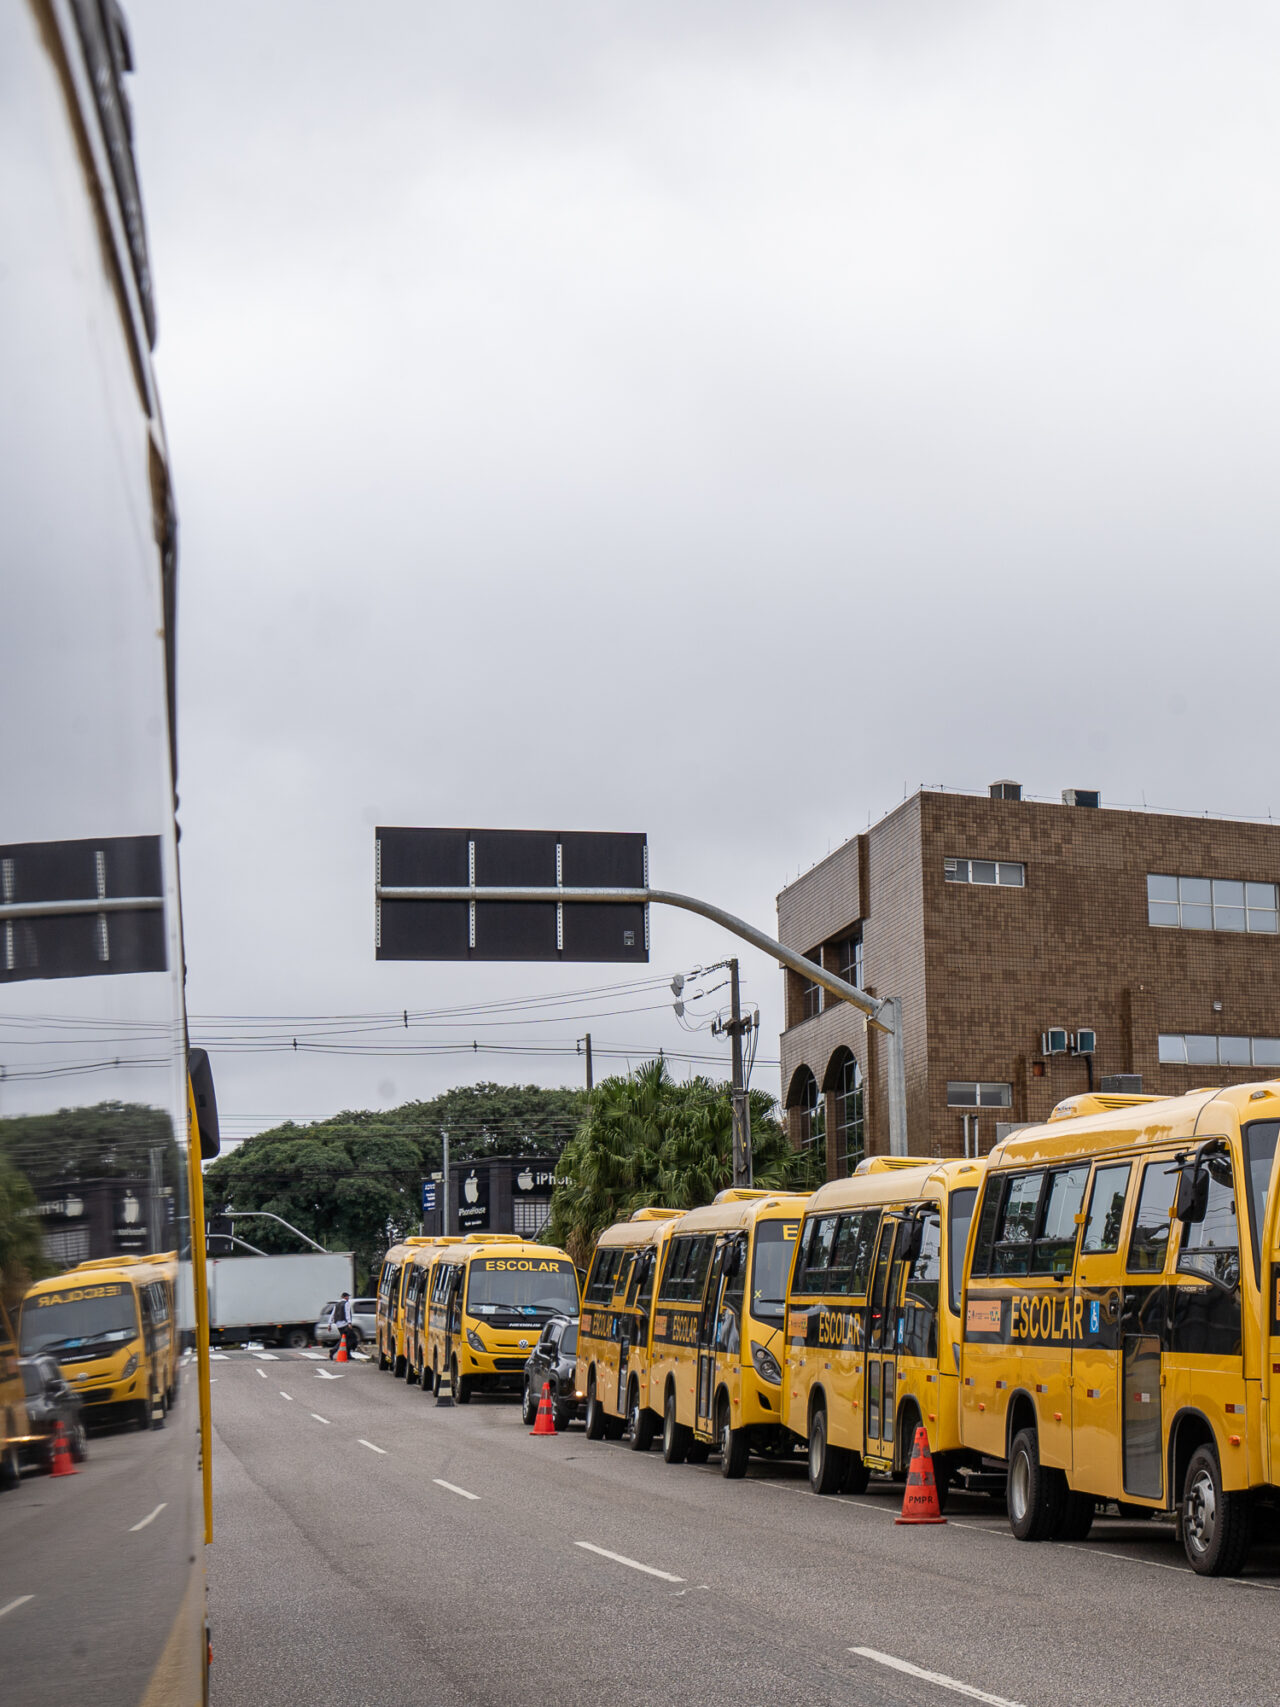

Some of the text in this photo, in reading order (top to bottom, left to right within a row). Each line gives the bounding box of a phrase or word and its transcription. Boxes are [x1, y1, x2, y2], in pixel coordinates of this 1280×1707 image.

[485, 1260, 560, 1273] ESCOLAR
[672, 1315, 698, 1344] ESCOLAR
[819, 1311, 861, 1345] ESCOLAR
[1010, 1295, 1084, 1340] ESCOLAR
[908, 1495, 934, 1505] PMPR
